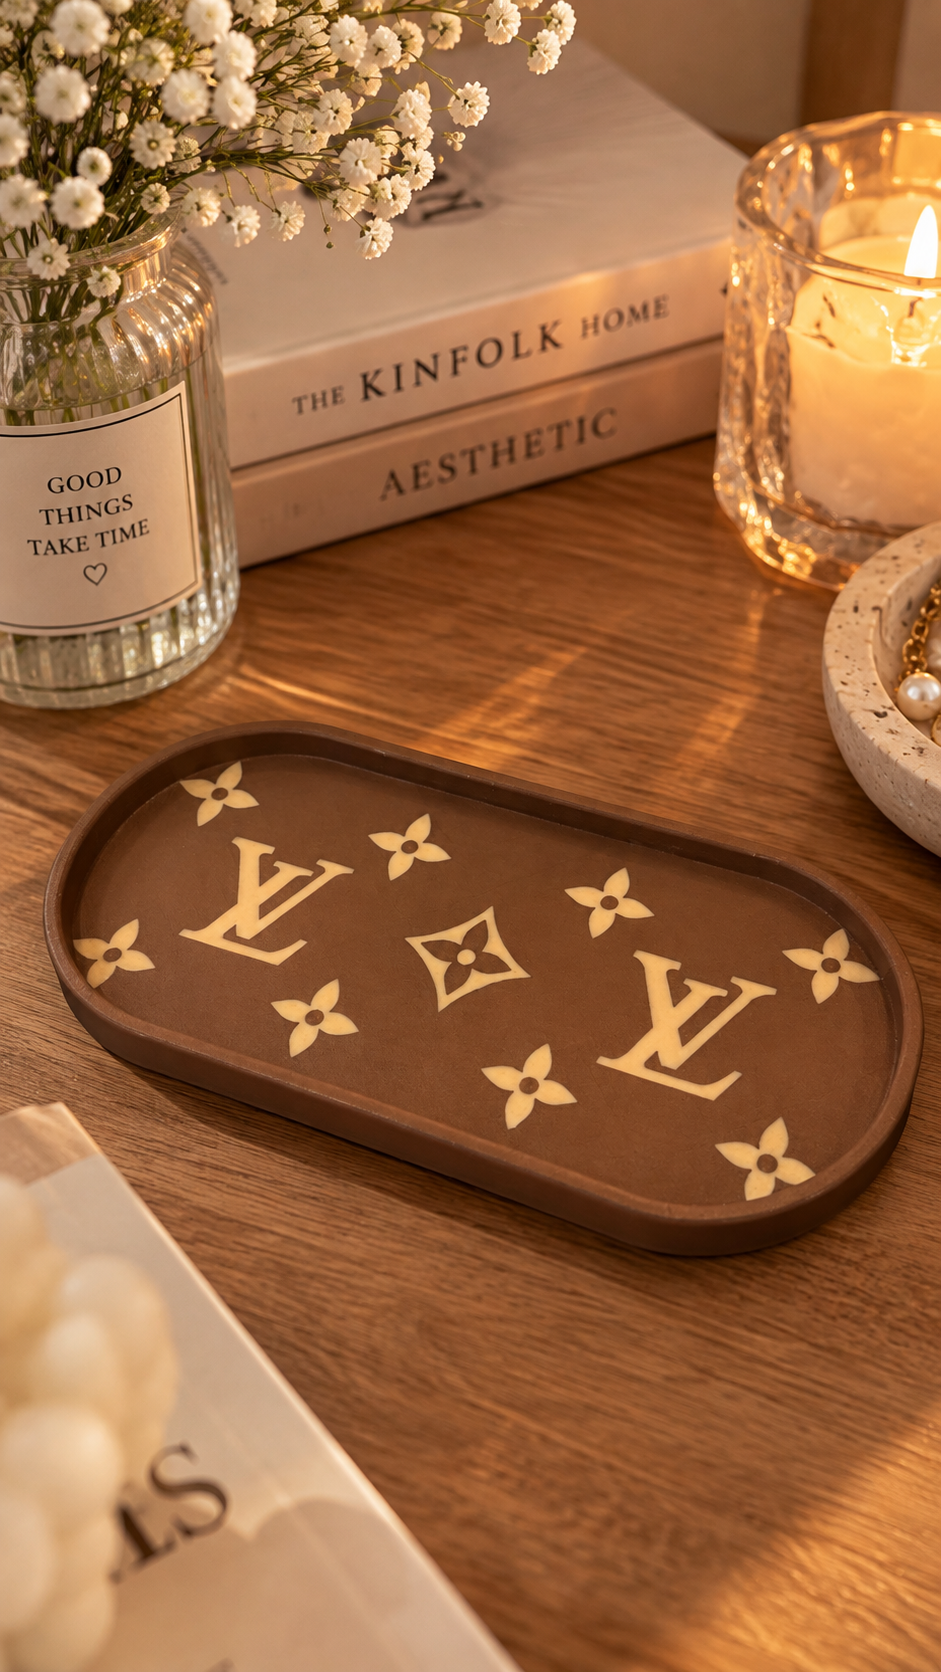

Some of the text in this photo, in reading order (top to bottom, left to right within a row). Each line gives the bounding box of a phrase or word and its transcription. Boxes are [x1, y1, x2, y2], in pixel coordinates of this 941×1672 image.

[291, 295, 670, 416] THE KINFOLK HOME
[379, 408, 617, 501] AESTHETIC
[46, 466, 122, 494] GOOD
[39, 493, 134, 526] THINGS
[27, 518, 151, 556] TAKE TIME
